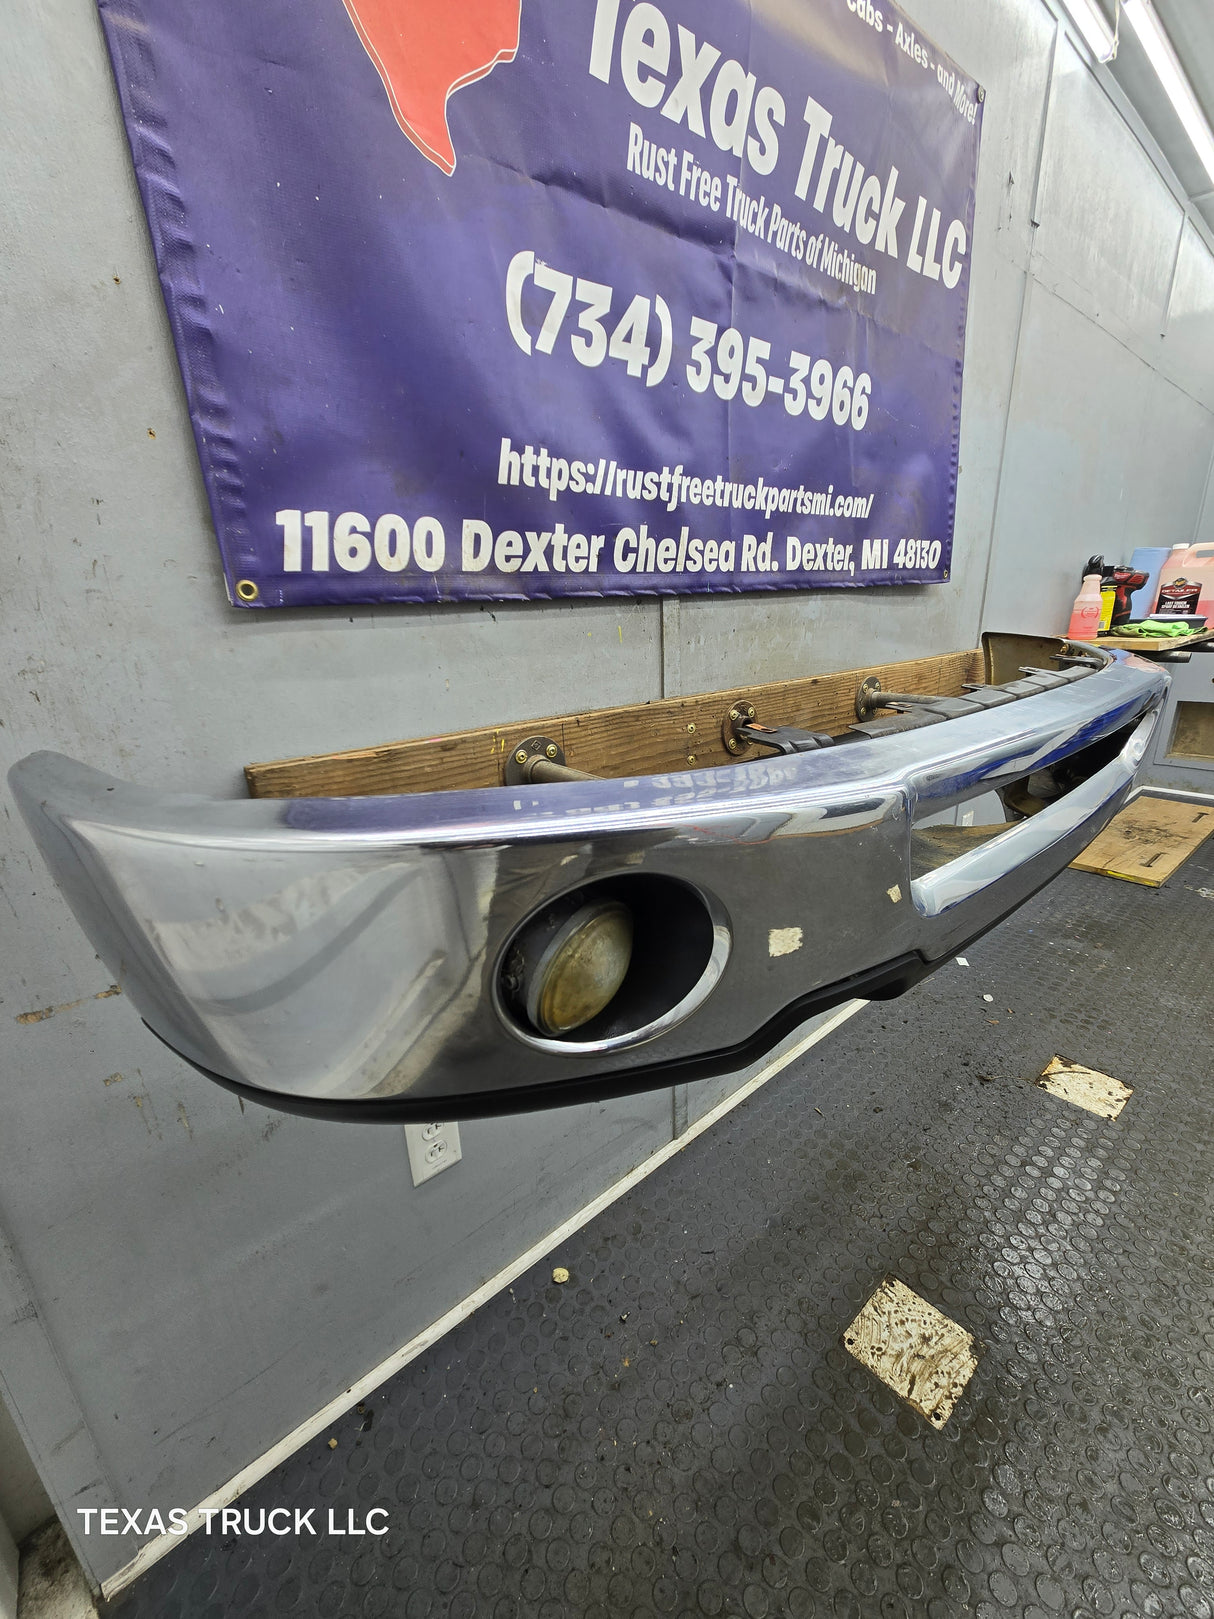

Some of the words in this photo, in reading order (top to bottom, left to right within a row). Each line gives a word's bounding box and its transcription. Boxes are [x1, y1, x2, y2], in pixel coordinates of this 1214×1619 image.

[895, 21, 929, 69] Axles
[936, 64, 956, 98] and
[952, 79, 978, 125] More!
[588, 0, 786, 176] Texas
[794, 96, 906, 259] Truck
[906, 195, 967, 290] LLC
[626, 121, 678, 192] Rust
[679, 149, 722, 213] Free
[726, 173, 770, 241] Truck
[767, 202, 807, 261] Parts
[806, 233, 824, 270] of
[821, 235, 877, 295] Michigan
[505, 250, 673, 387] (734)
[686, 316, 872, 431] 395-3966
[275, 509, 446, 573] 11600
[461, 518, 606, 573] Dexter
[613, 524, 736, 573] Chelsea
[740, 531, 779, 573] Rd.
[785, 535, 856, 577] Dexter,
[860, 538, 890, 571] MI
[892, 538, 942, 570] 48130
[497, 437, 875, 519] https://rustfreetruckpartsmi.com/
